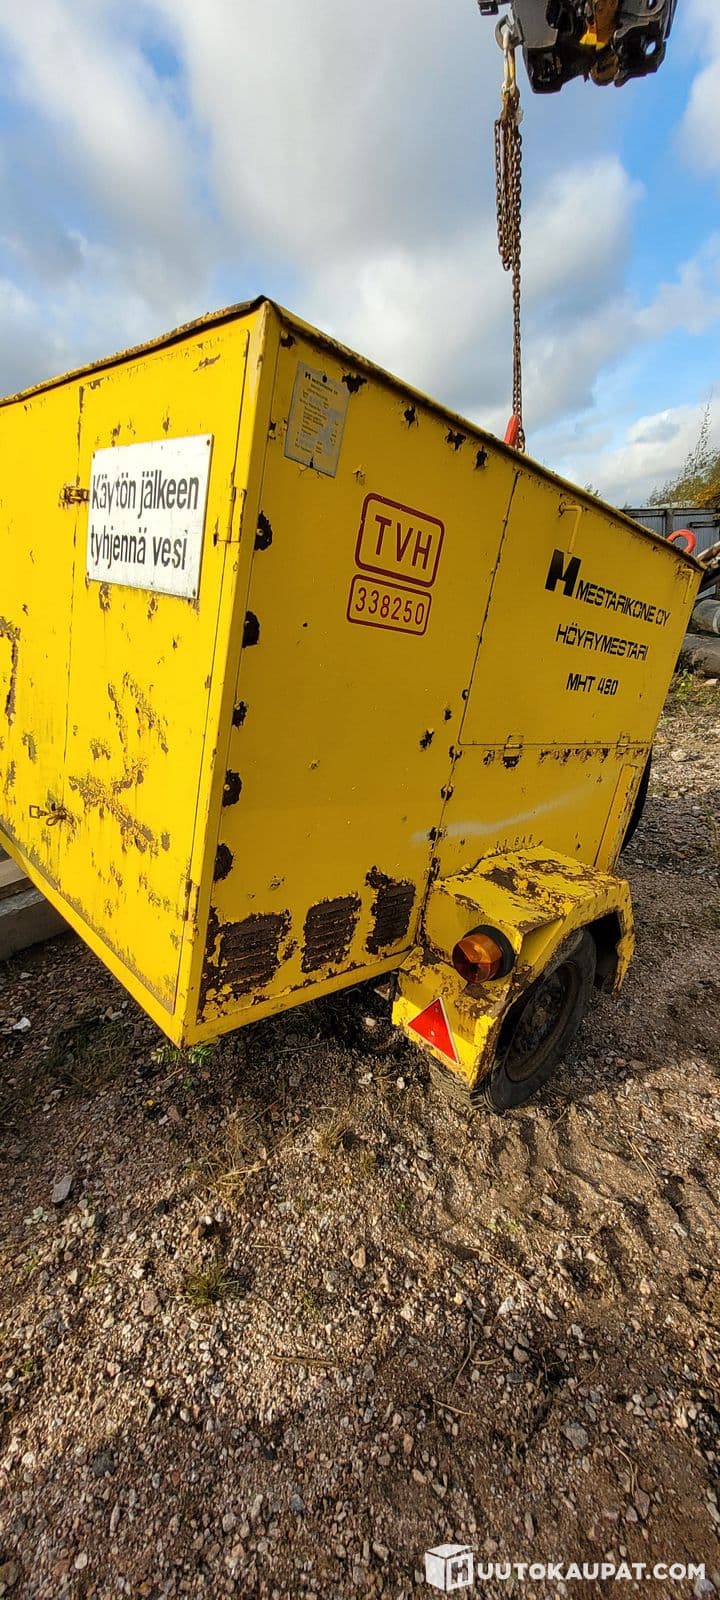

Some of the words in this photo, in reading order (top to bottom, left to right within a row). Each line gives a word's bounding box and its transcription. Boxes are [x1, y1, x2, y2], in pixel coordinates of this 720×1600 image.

[92, 472, 136, 515] Käytön
[137, 469, 199, 519] jälkeen
[90, 525, 147, 569] tyhjennä
[152, 529, 188, 570] vesi
[374, 514, 433, 570] TVH
[355, 587, 425, 625] 338250
[575, 580, 657, 623] MESTARIKONE
[655, 608, 671, 627] OY
[555, 622, 649, 661] HÖYRYMESTARI
[566, 672, 596, 693] MHT
